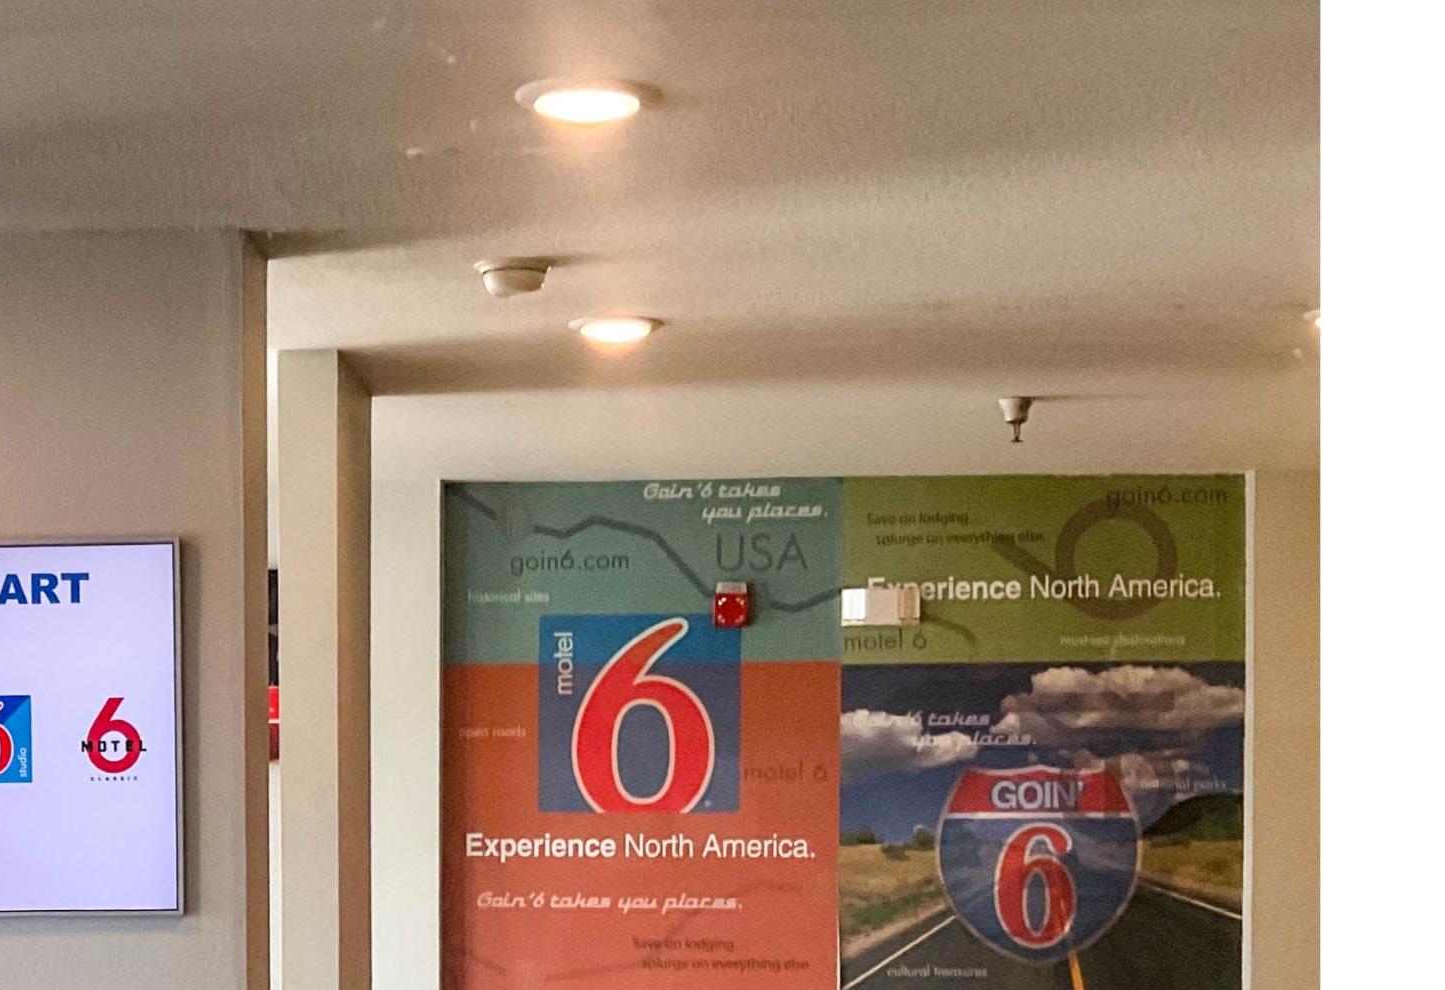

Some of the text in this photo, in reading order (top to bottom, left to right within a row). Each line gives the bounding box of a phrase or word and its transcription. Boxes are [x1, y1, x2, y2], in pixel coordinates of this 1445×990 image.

[718, 482, 782, 498] takes
[1106, 485, 1228, 506] goin6.com
[702, 502, 828, 524] you places.
[946, 531, 1015, 545] everything
[510, 550, 630, 576] goin6.com
[714, 532, 808, 573] USA
[467, 588, 549, 603] historical sites
[1031, 573, 1100, 599] North
[1108, 573, 1221, 599] America.
[844, 627, 927, 651] motel 6
[554, 632, 573, 695] motel
[571, 617, 715, 814] 6
[928, 711, 990, 726] takes
[86, 697, 142, 774] 6
[492, 725, 526, 739] roads
[81, 739, 147, 753] MOTEL
[19, 747, 28, 779] studio
[744, 760, 828, 784] motel 6
[465, 832, 816, 861] Experience North America.
[994, 822, 1077, 950] 6
[550, 893, 610, 909] takes
[618, 896, 658, 914] you
[661, 893, 743, 914] places.
[712, 958, 781, 972] everything
[887, 964, 988, 977] cultural treasures
